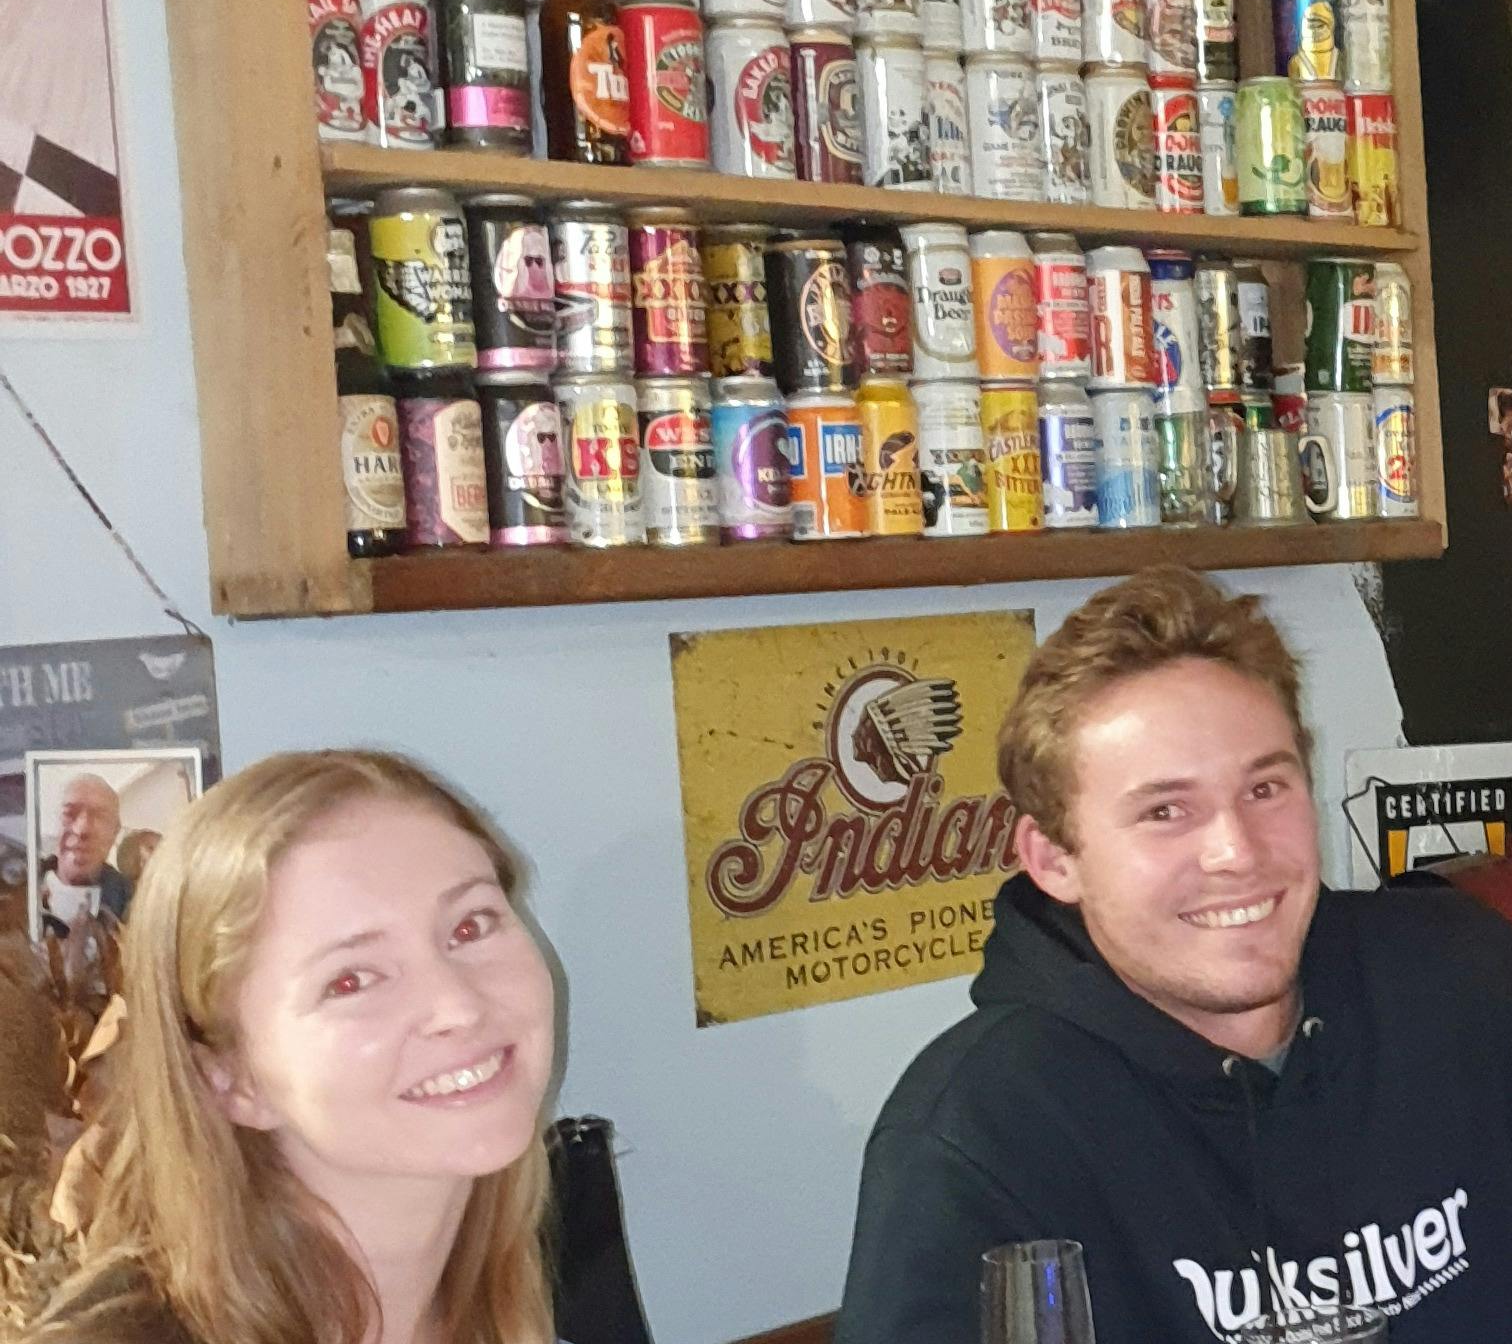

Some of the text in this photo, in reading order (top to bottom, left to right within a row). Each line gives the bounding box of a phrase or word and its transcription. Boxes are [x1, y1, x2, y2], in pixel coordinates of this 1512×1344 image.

[0, 227, 122, 272] OZZO
[66, 276, 111, 300] 1927
[813, 646, 919, 732] SINCE 1901
[1385, 787, 1506, 818] CERTIFIED
[707, 757, 1022, 918] Indian
[718, 898, 995, 971] AMERICA'S PIONE
[786, 929, 985, 991] MOTORCYCLE
